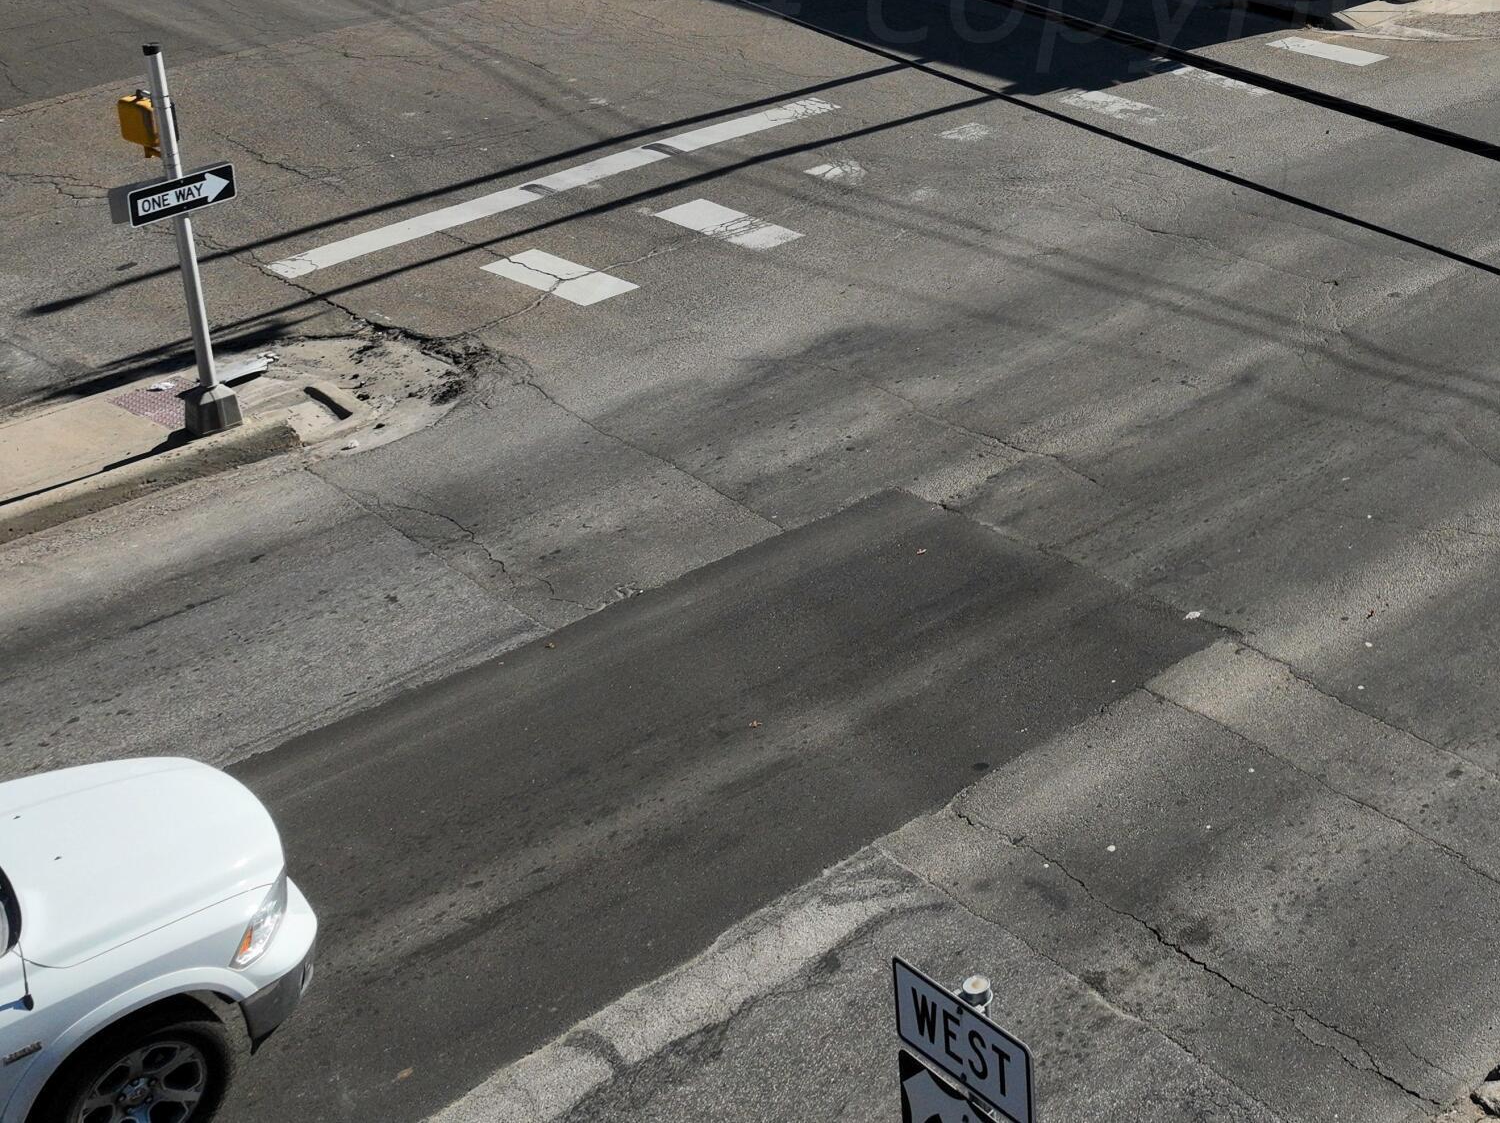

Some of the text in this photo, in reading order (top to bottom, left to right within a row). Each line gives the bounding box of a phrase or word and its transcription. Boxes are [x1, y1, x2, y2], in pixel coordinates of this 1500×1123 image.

[141, 183, 204, 212] ONE WAY
[911, 987, 1011, 1098] WEST
